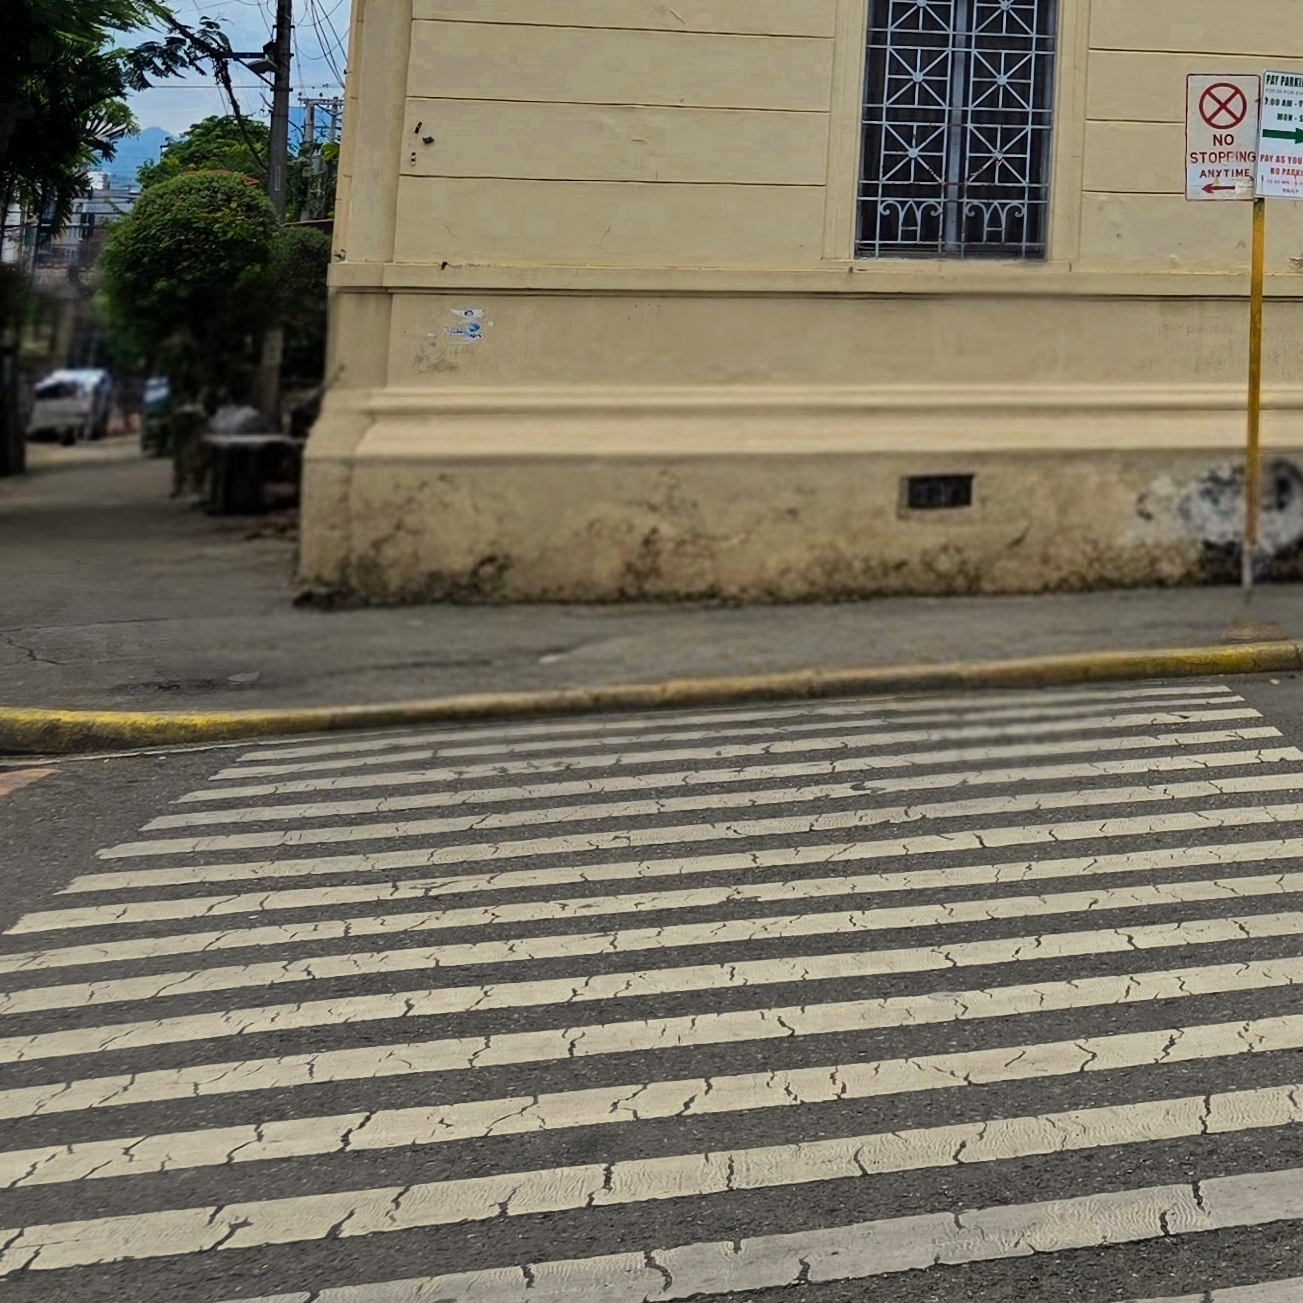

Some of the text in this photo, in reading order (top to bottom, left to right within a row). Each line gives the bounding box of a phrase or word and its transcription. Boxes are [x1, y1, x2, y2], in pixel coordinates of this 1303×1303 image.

[1266, 74, 1280, 86] PAY
[1281, 99, 1293, 107] AM
[1277, 113, 1293, 121] MON
[1213, 134, 1234, 146] NO
[1190, 151, 1256, 164] STOPPING
[1260, 154, 1273, 162] PAY
[1275, 155, 1285, 164] AS
[1288, 156, 1302, 165] YOU
[1199, 168, 1251, 178] ANYTIME
[1270, 167, 1280, 175] NO
